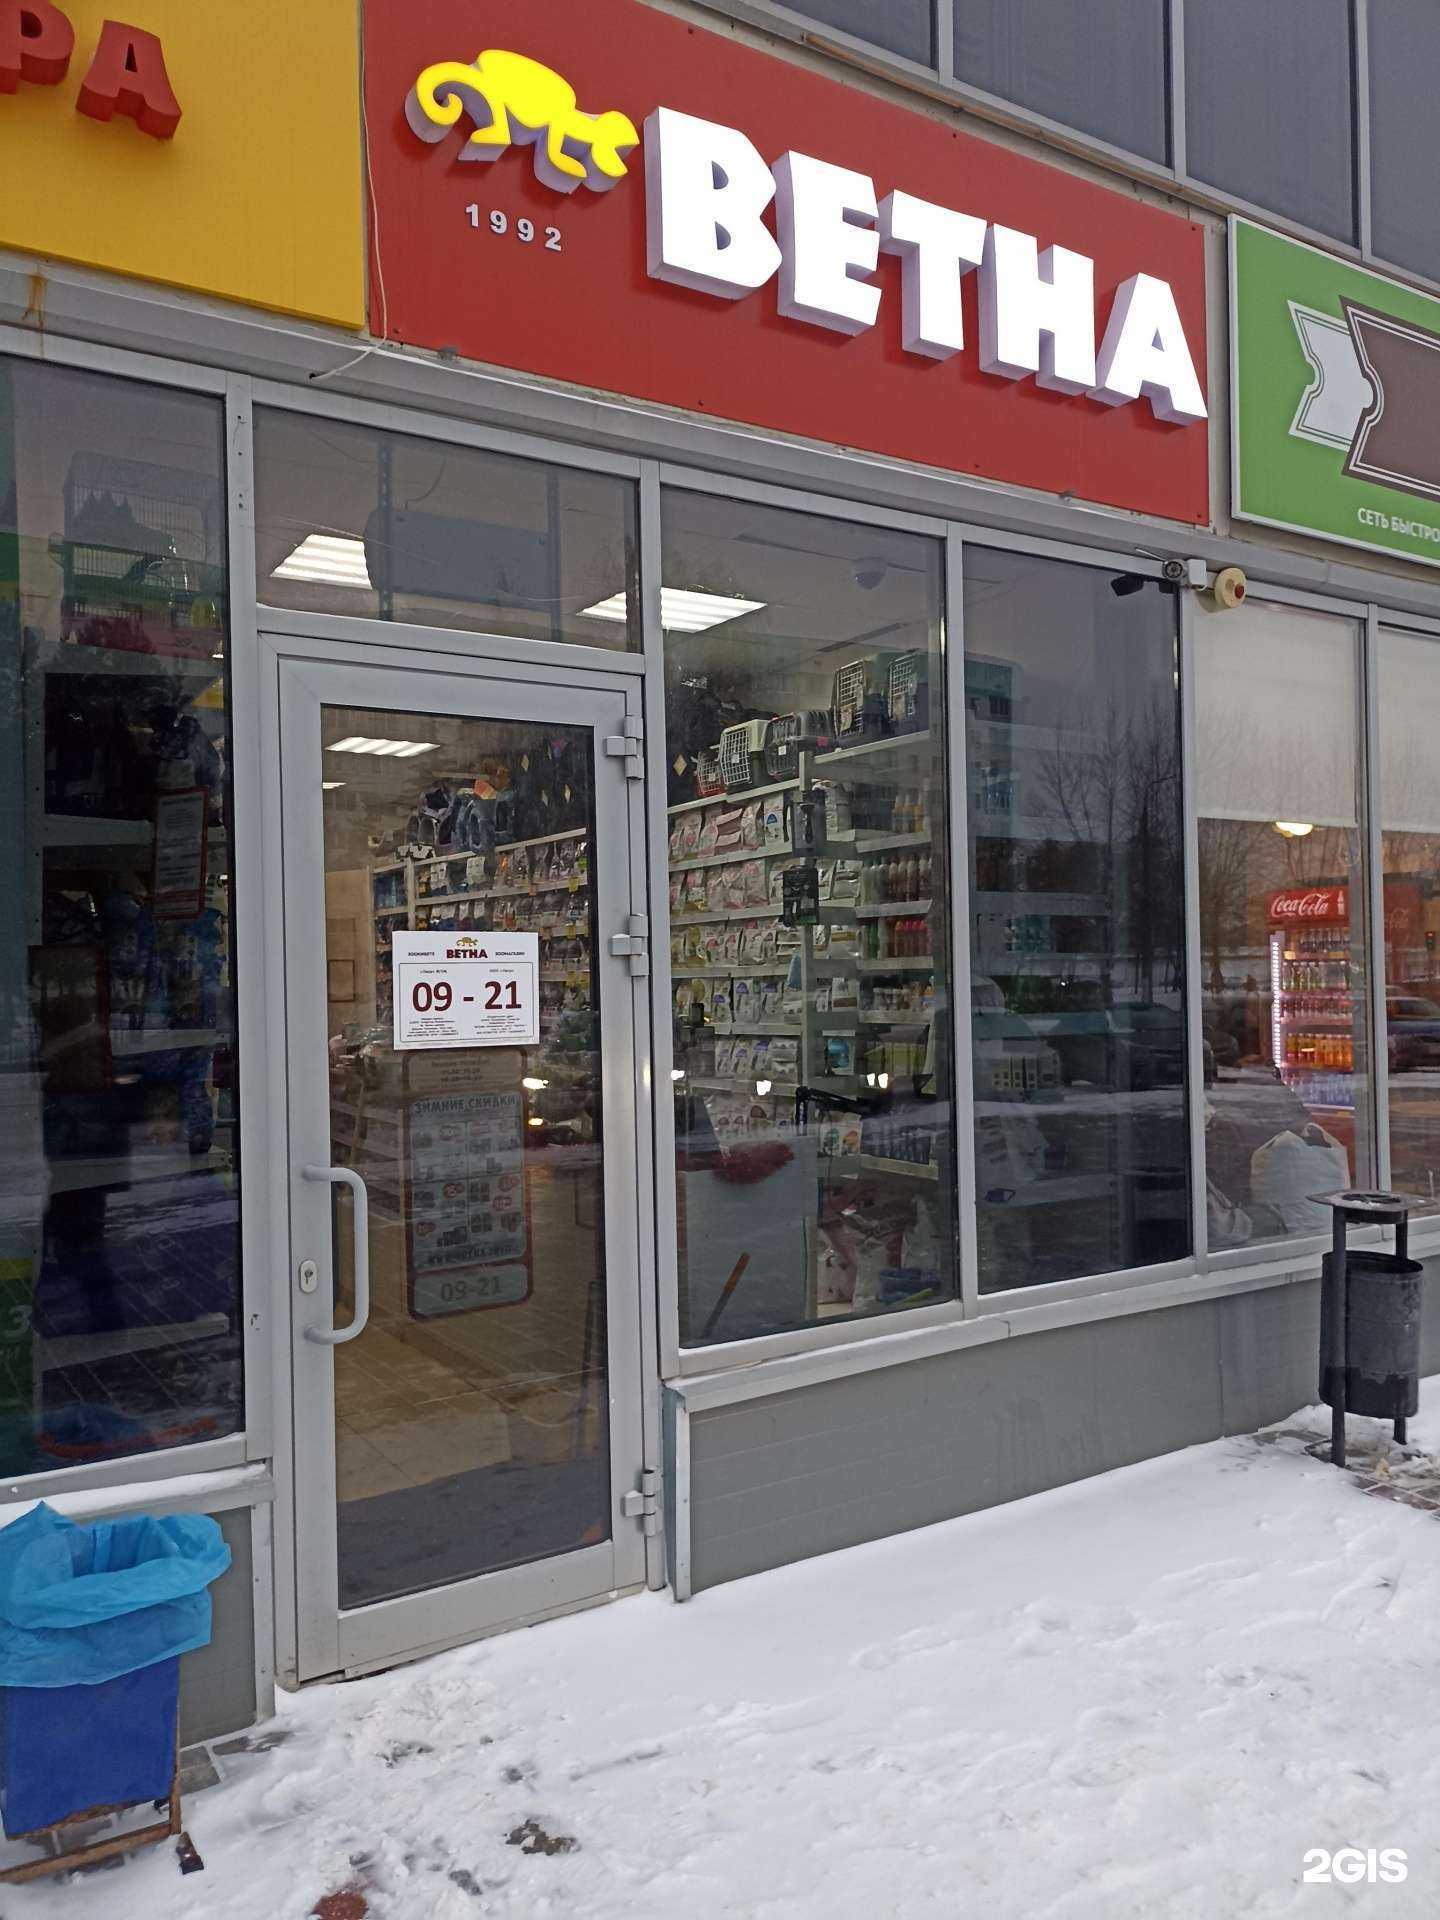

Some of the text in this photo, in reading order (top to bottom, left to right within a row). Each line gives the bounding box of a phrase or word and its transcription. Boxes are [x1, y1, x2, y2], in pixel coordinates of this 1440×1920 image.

[465, 203, 562, 252] 1992
[648, 107, 1208, 424] ВЕТНА
[1357, 507, 1390, 529] СЕТЬ
[446, 949, 488, 959] ВЕТНА
[412, 981, 453, 1012] 09
[484, 980, 522, 1010] 21
